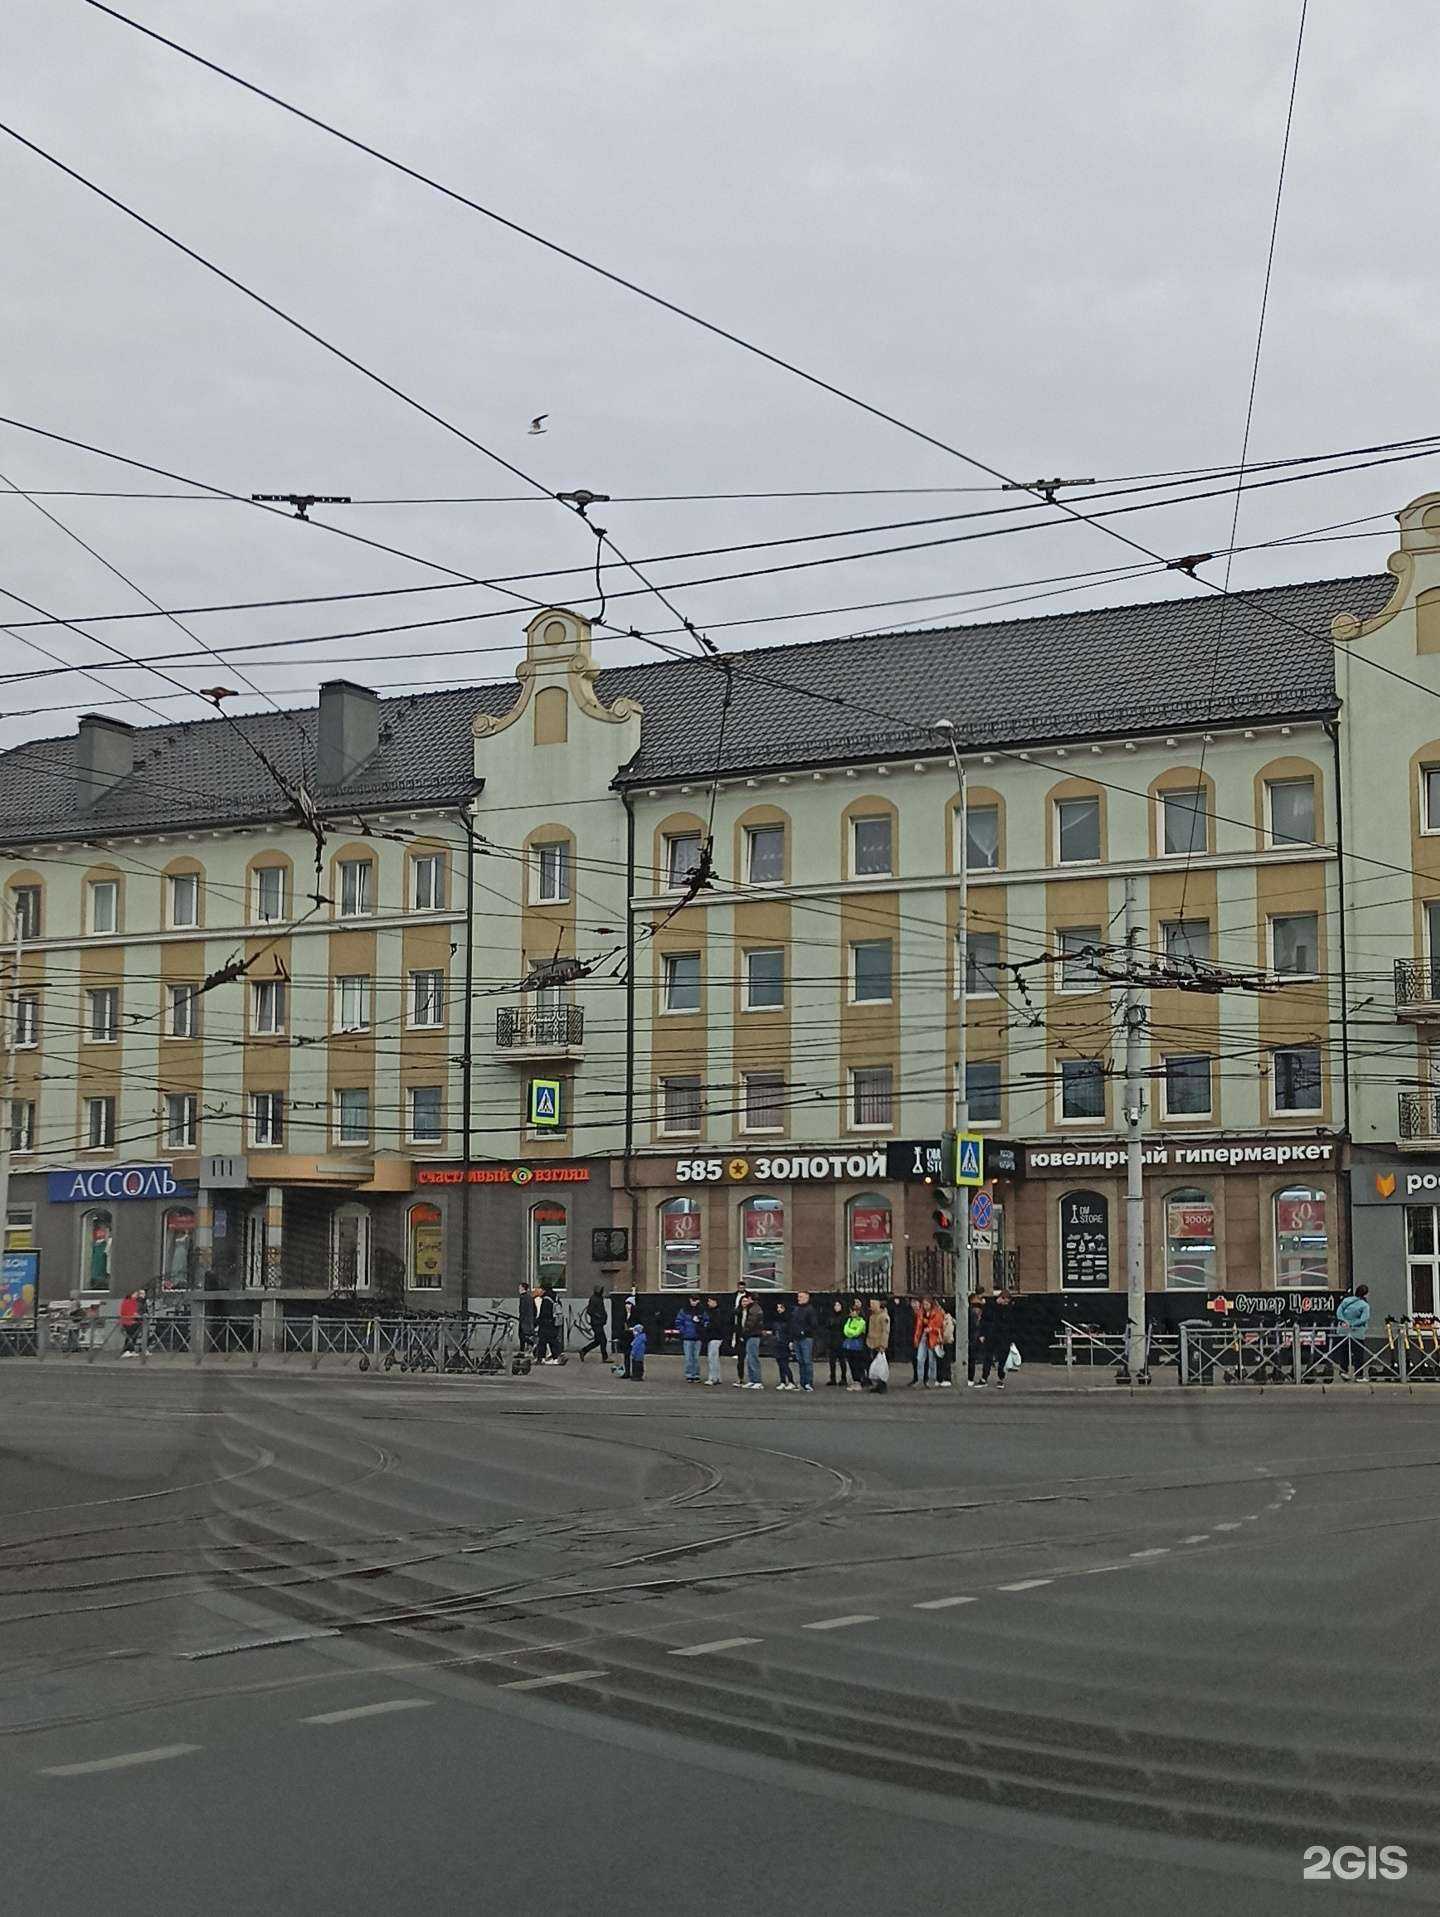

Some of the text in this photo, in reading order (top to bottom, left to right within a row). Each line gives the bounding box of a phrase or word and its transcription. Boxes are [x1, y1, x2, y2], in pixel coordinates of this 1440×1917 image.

[676, 1151, 887, 1181] 585 ЗОЛОТОЙ
[1030, 1146, 1168, 1169] ювелирный
[1175, 1144, 1333, 1166] гипермаркет
[70, 1170, 177, 1197] АССОЛЬ
[535, 1168, 590, 1182] взгляд
[1407, 1174, 1440, 1195] ро
[1235, 1293, 1335, 1315] Супер Цены
